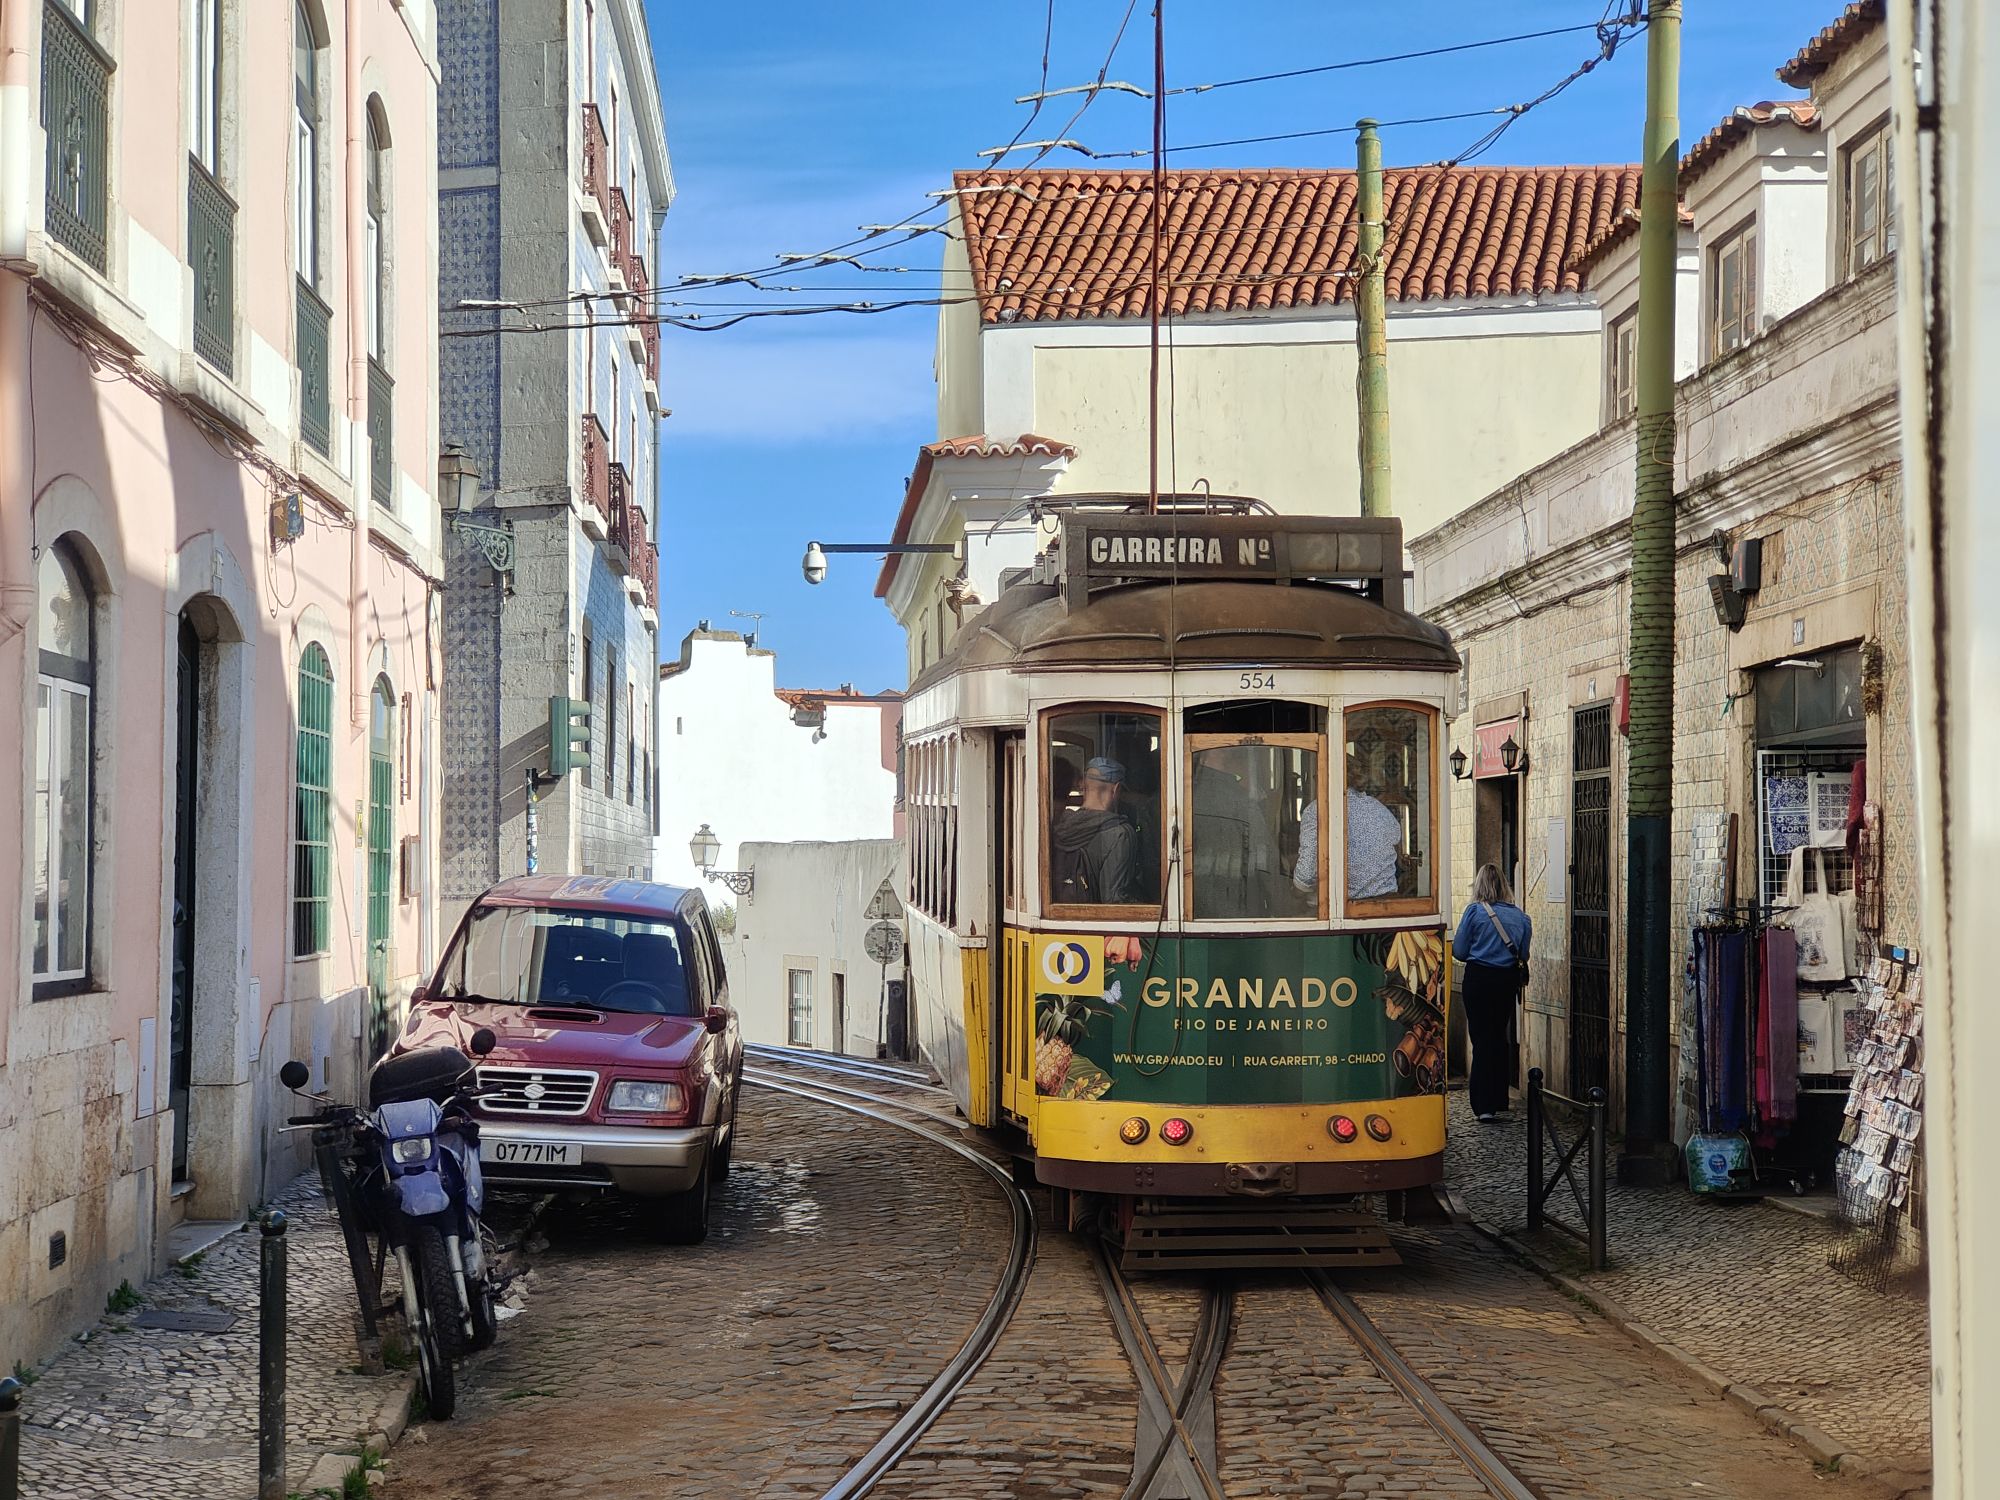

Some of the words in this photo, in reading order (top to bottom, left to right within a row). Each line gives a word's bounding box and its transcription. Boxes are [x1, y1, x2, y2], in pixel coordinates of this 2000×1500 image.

[1091, 536, 1222, 564] CARREIRA
[1239, 672, 1276, 690] 554
[1141, 977, 1358, 1009] GRANADO
[1174, 1019, 1206, 1031] RIO
[1215, 1019, 1238, 1031] DE
[1246, 1019, 1328, 1031] JANEIRO
[1113, 1053, 1223, 1067] WWW.GRANADO.EU
[1243, 1056, 1268, 1067] RUA
[1270, 1055, 1323, 1067] GARRETT,
[1325, 1055, 1338, 1065] 98
[1347, 1052, 1386, 1065] CHIADO
